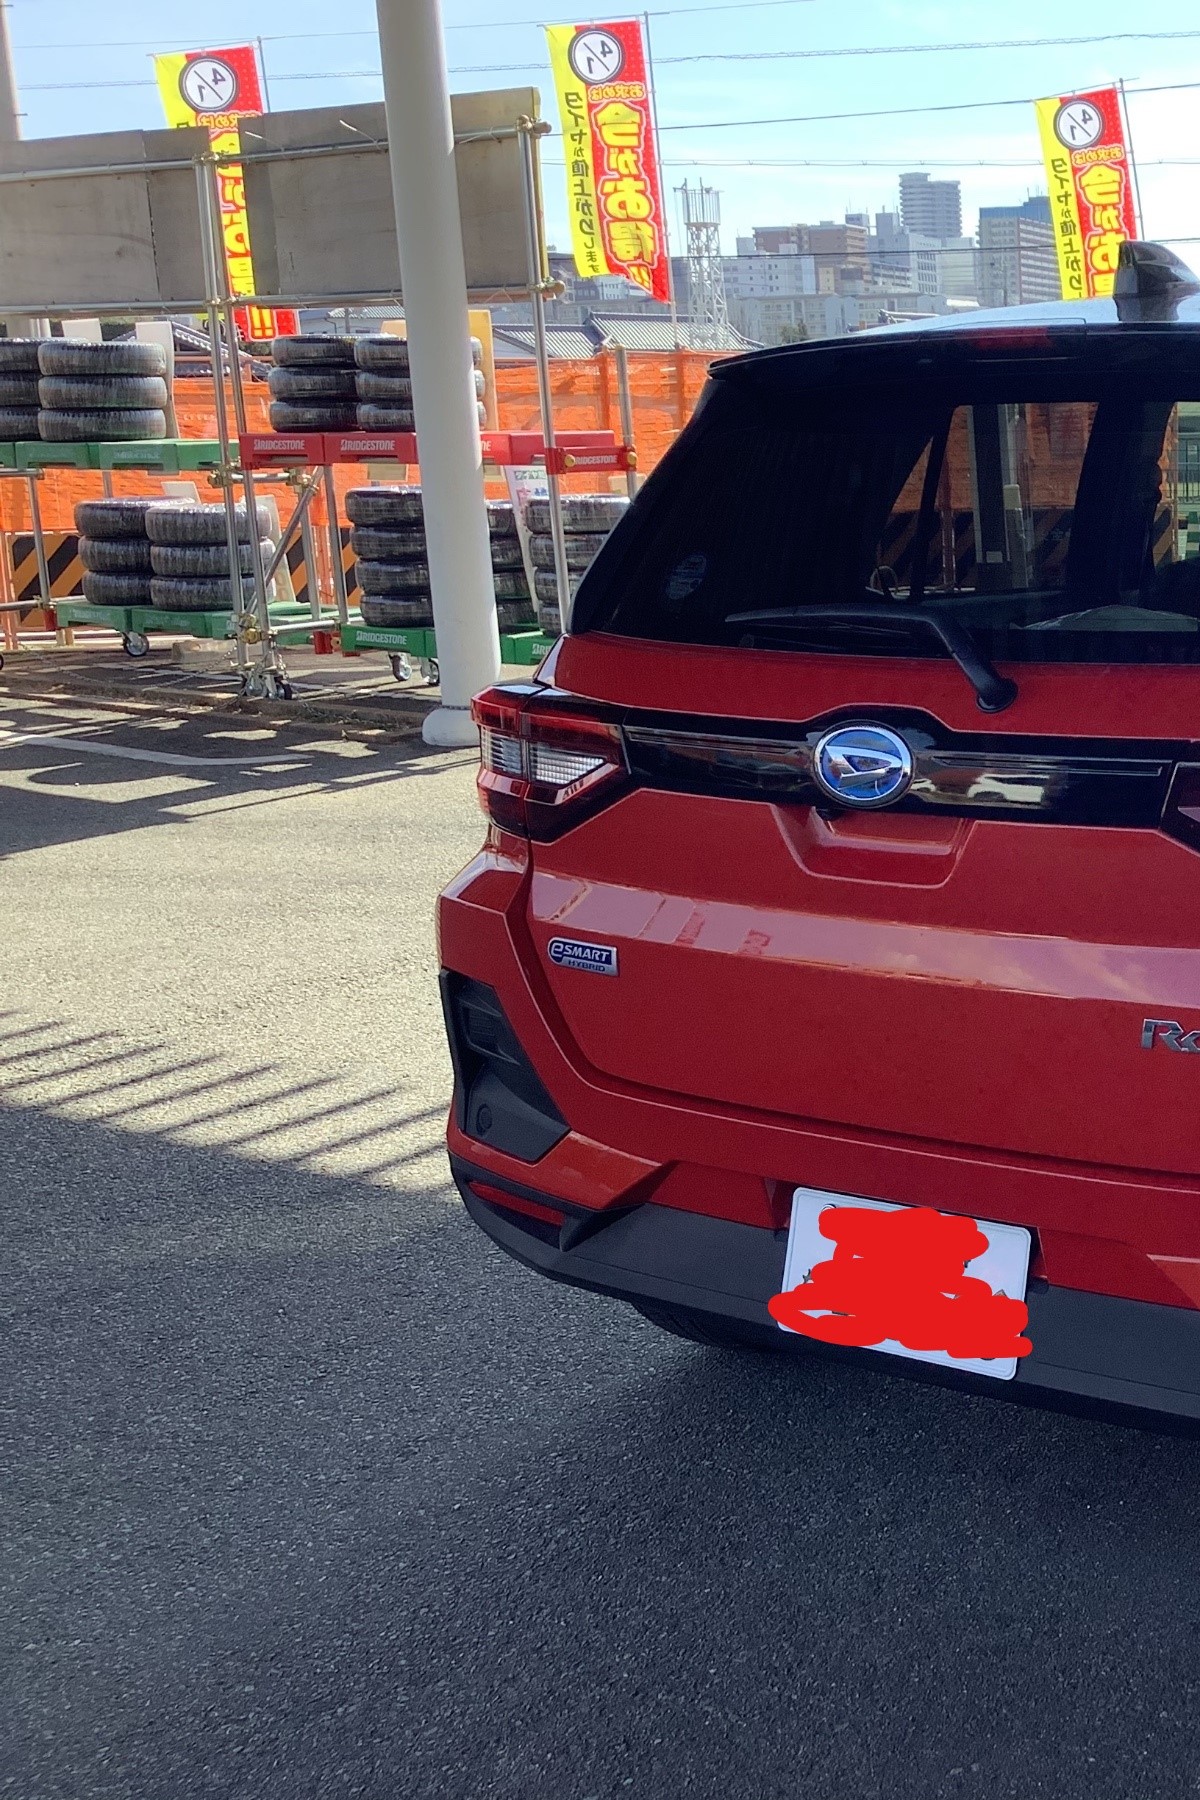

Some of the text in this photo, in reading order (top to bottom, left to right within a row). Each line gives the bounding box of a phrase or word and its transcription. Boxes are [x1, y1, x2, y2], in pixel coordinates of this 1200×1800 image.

[254, 439, 305, 451] BRIDGESTONE
[341, 439, 395, 451] BRIDGESTONE
[574, 455, 618, 465] RIDGESTONE
[356, 630, 408, 645] BRIDGESTONE
[567, 959, 606, 973] HYBRID
